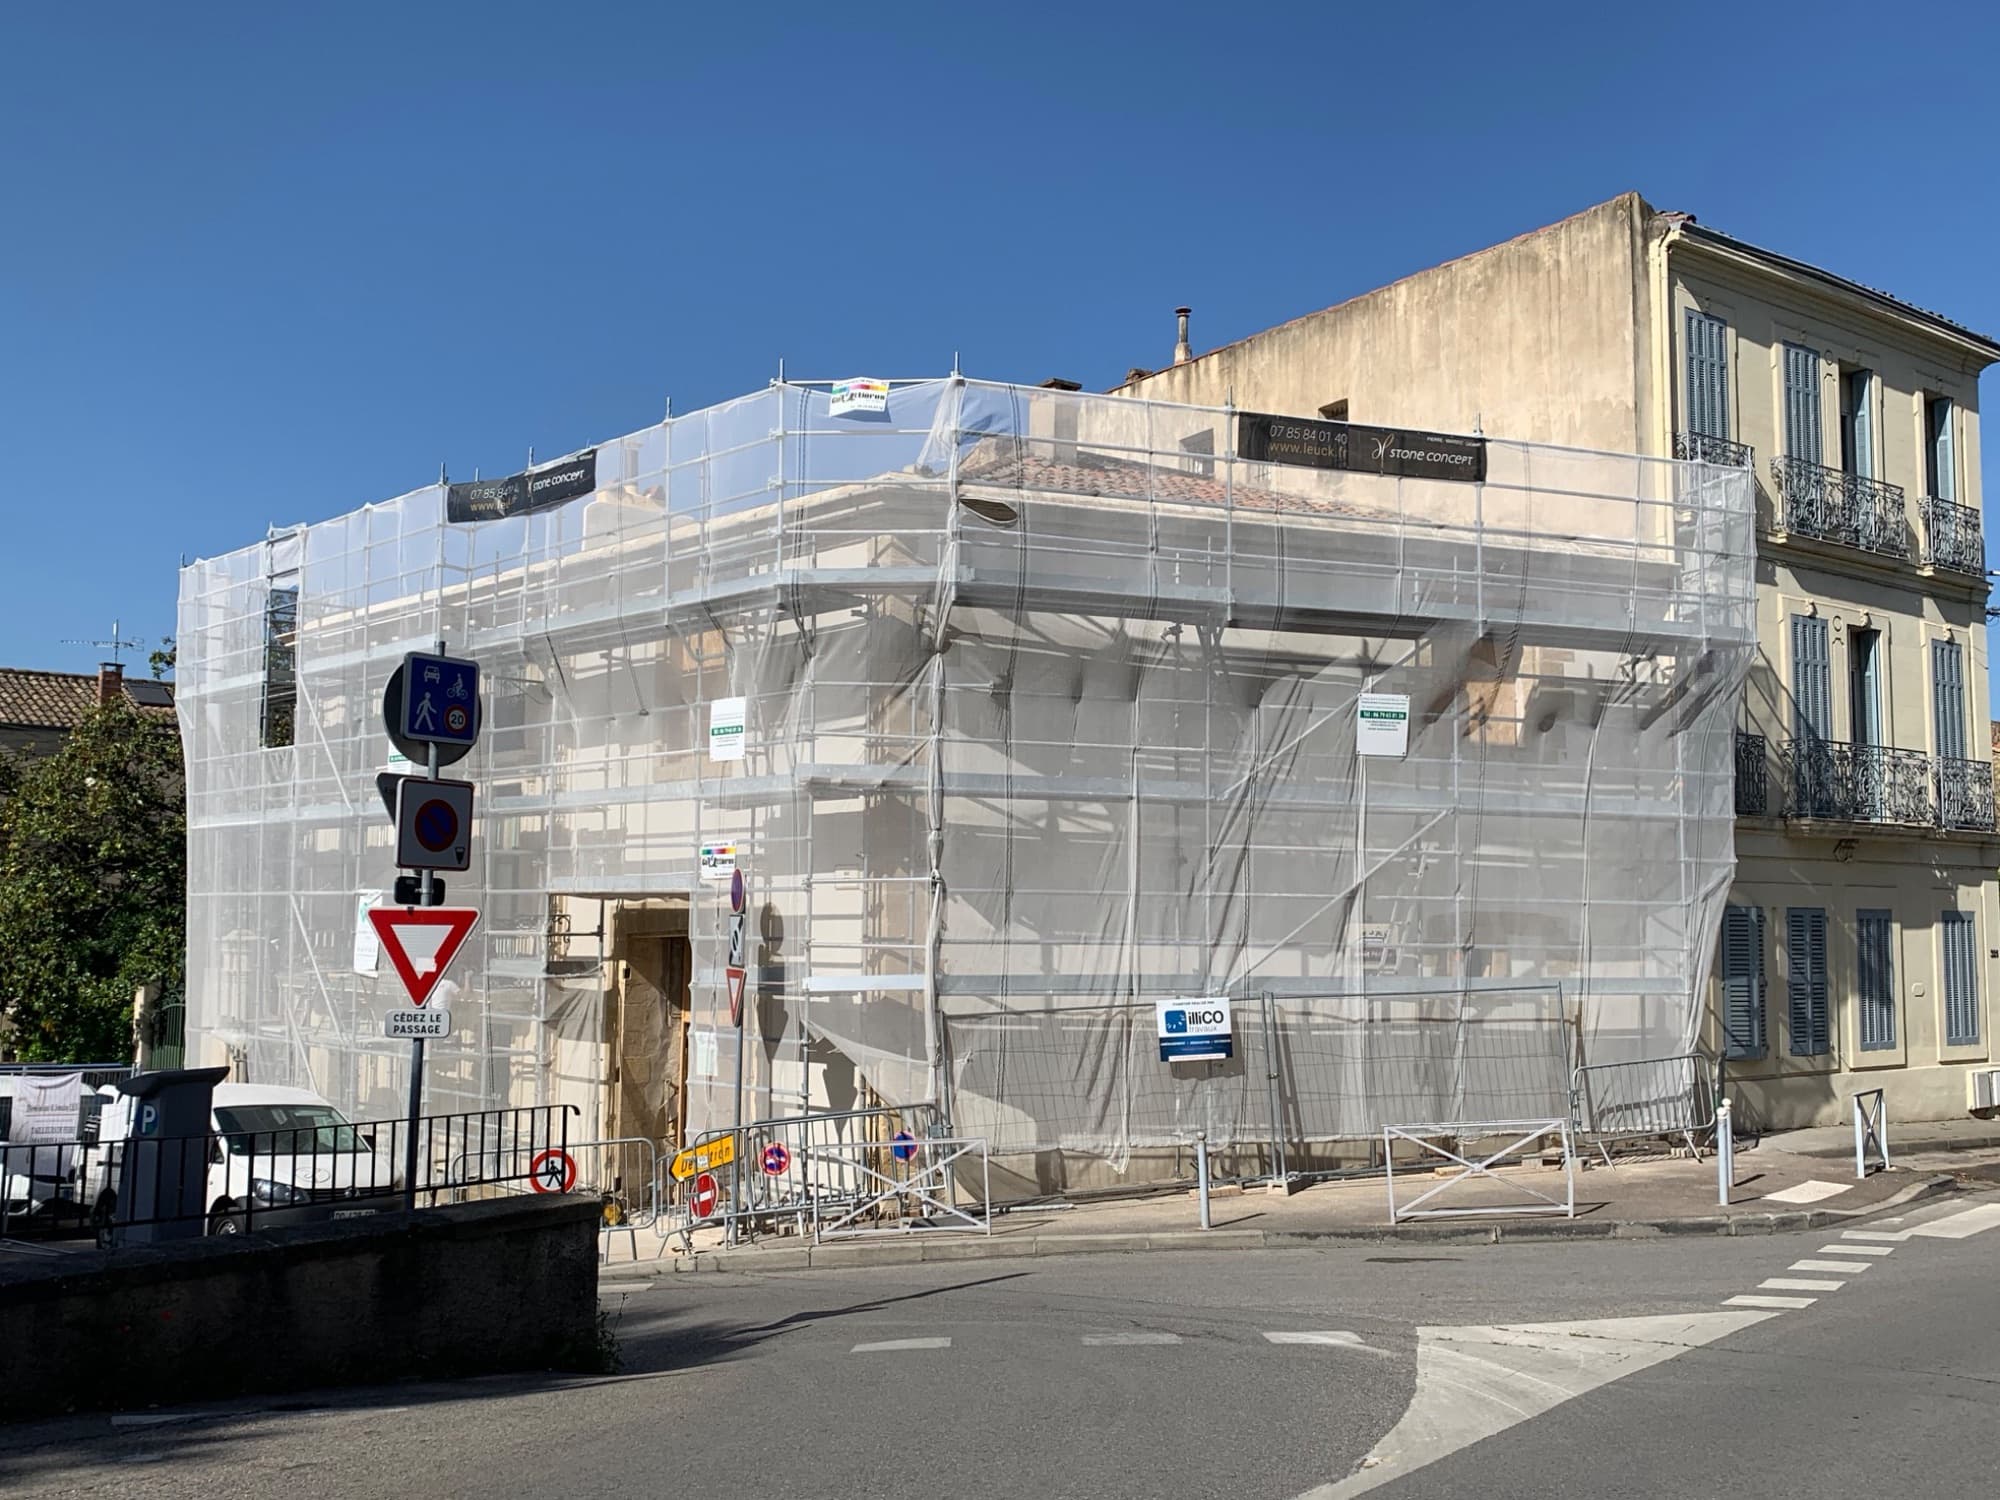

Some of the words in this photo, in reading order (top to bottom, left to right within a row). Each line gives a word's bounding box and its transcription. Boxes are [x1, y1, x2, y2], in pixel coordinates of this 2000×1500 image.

[1270, 425, 1284, 437] 07
[1287, 427, 1300, 439] 85
[1303, 428, 1316, 440] 84
[1319, 431, 1331, 442] 01
[1334, 433, 1347, 445] 40
[451, 714, 464, 725] 20
[394, 1012, 425, 1022] CÉDEZ
[430, 1013, 441, 1022] LE
[393, 1025, 440, 1034] PASSAGE
[142, 1105, 156, 1133] P
